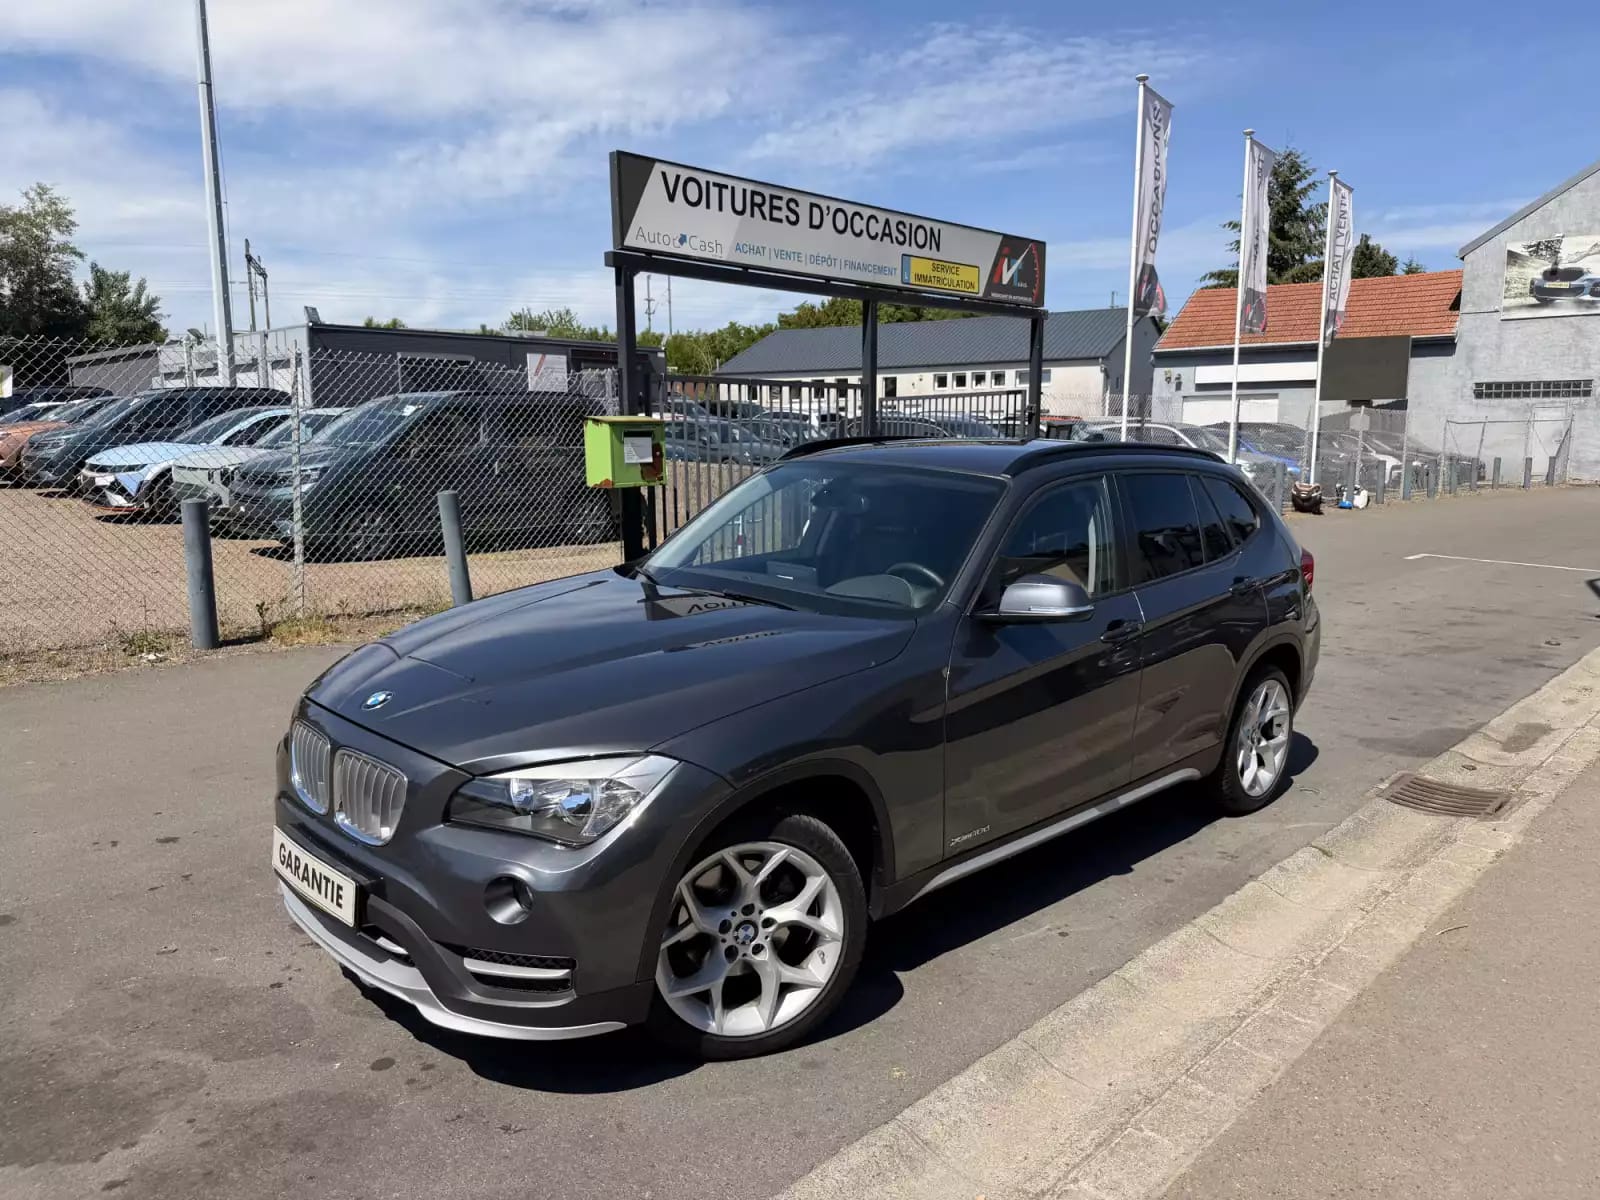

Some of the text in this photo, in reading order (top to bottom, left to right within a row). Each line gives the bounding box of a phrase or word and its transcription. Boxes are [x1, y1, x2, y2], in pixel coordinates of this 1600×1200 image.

[661, 171, 941, 252] VOITURES D'OCCASION
[636, 226, 723, 254] Auto Cash
[735, 242, 898, 277] ACHAT VENTE DÉPÔT FINANCEMENT
[931, 262, 960, 276] SERVICE
[914, 272, 976, 290] IMMATRICULATION
[1329, 254, 1342, 301] ACHAT
[279, 843, 344, 909] GARANTIE
